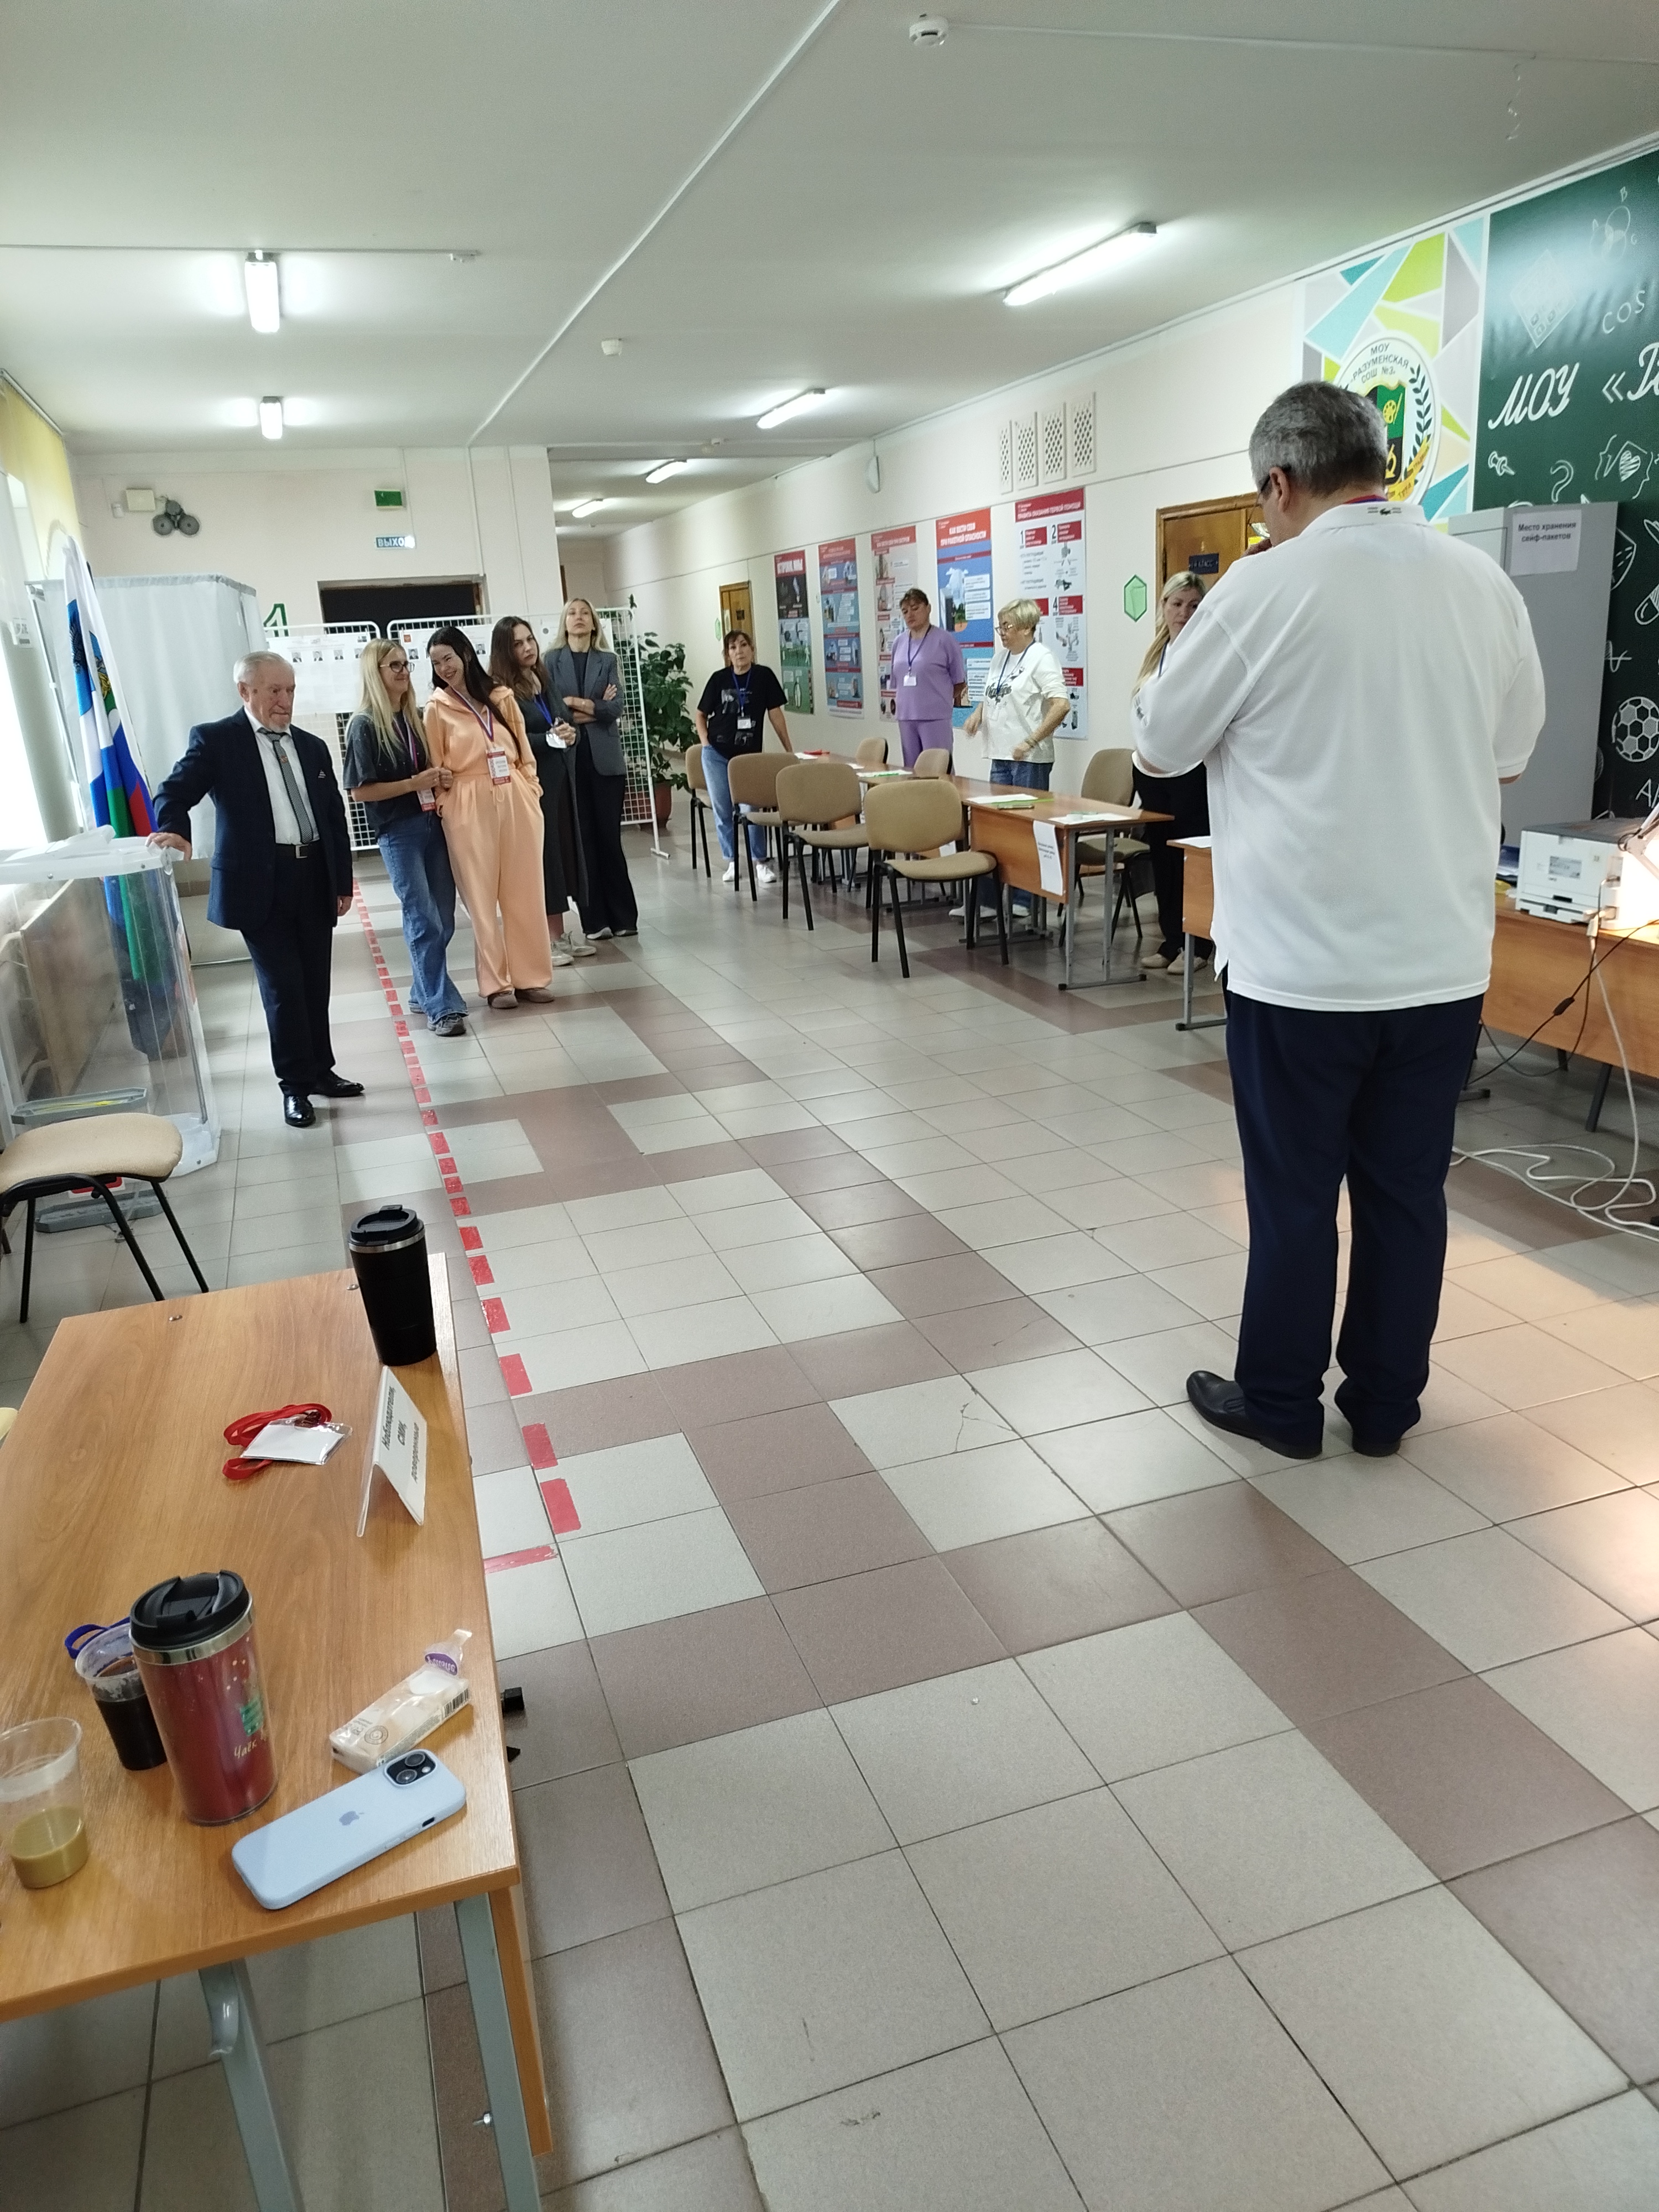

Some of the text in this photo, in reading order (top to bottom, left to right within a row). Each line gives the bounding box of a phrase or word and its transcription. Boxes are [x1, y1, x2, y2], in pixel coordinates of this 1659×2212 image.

[1370, 343, 1390, 354] МОУ
[1361, 368, 1378, 383] СОШ
[1488, 362, 1580, 429] МОУ
[1052, 524, 1056, 540] 2
[1541, 523, 1576, 531] хранения
[377, 537, 413, 549] ВЫХО
[1053, 597, 1058, 611] 4
